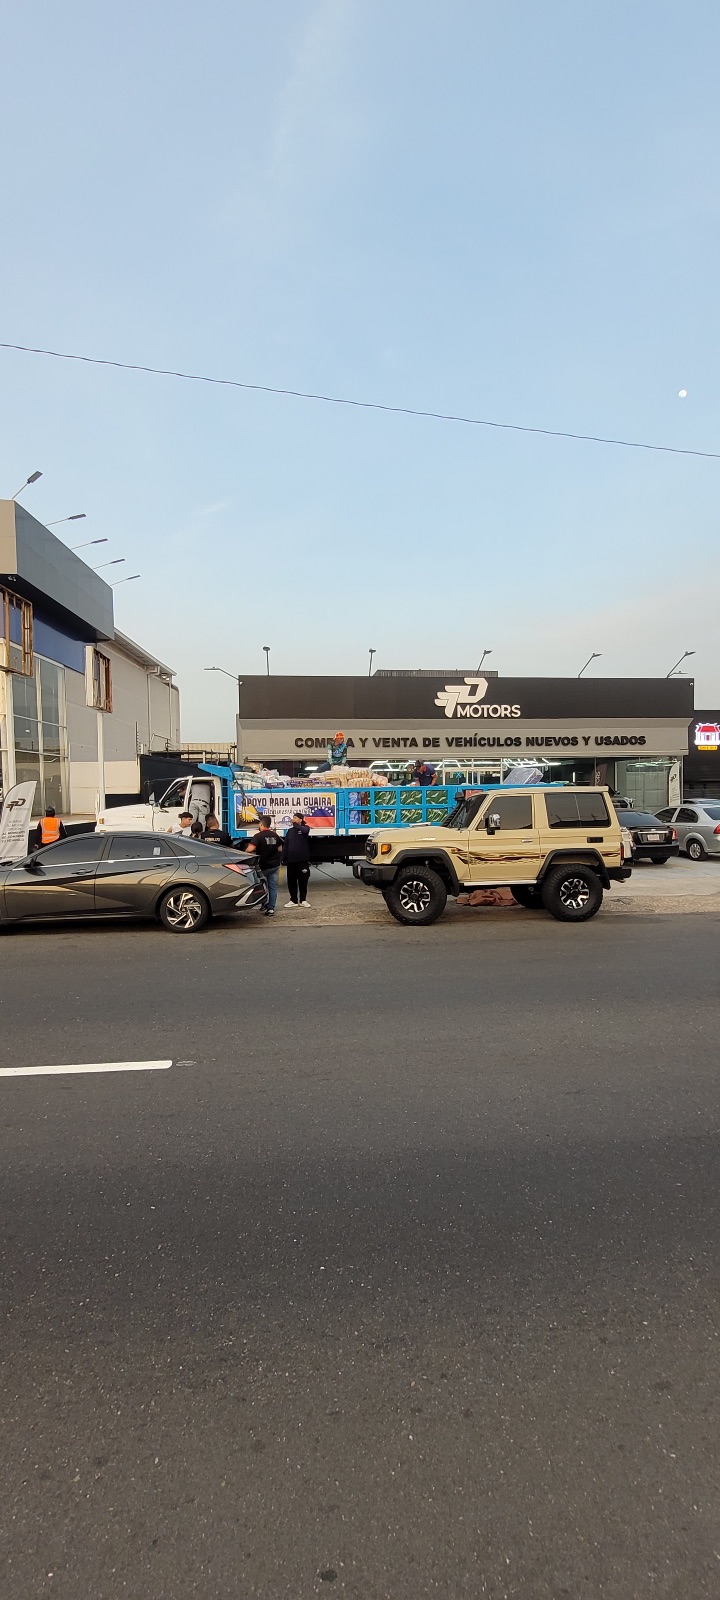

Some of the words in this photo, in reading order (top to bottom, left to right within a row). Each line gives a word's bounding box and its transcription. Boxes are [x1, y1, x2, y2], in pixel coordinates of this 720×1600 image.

[456, 704, 521, 718] MOTORS
[294, 737, 355, 748] COMPA
[358, 737, 368, 748] Y
[372, 737, 419, 748] VENTA
[422, 736, 441, 747] DE
[445, 733, 522, 747] VEHÍCULOS
[525, 736, 579, 747] NUEVOS
[582, 736, 591, 746] Y
[594, 735, 647, 746] USADOS
[241, 797, 267, 807] APOYO
[269, 797, 290, 806] PARA
[291, 797, 301, 806] LA
[303, 796, 332, 806] GUAIRA
